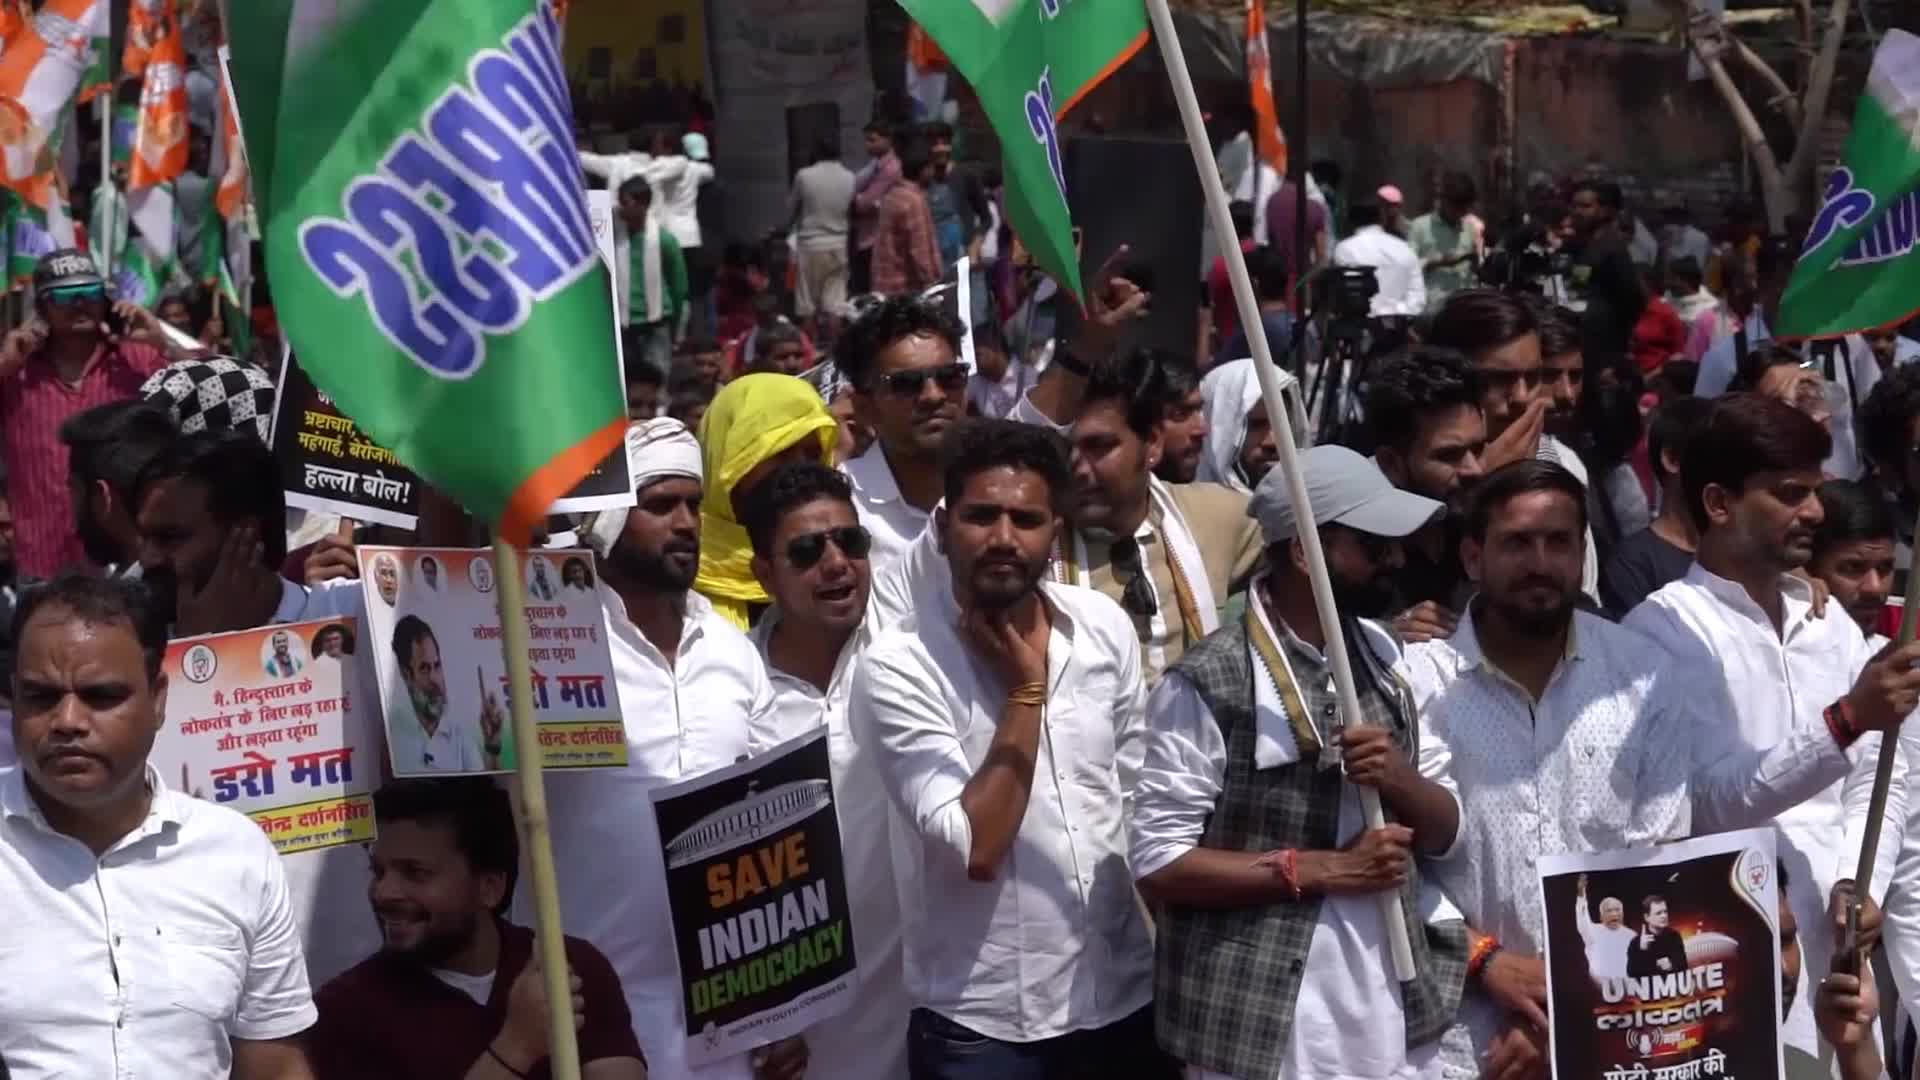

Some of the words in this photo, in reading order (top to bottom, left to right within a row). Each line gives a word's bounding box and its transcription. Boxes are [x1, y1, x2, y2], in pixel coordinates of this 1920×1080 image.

[303, 462, 359, 494] हल्ला
[361, 468, 411, 504] बोल!
[556, 674, 607, 708] मत
[180, 711, 234, 736] लोकतंत्र
[237, 708, 253, 725] के
[315, 699, 338, 713] रहा
[216, 733, 242, 752] और
[244, 729, 284, 750] लड़ता
[210, 751, 276, 803] डरो
[287, 746, 356, 787] मत
[706, 831, 810, 909] SAVE
[697, 877, 830, 971] INDIAN
[690, 919, 843, 1015] DEMOCRACY
[1602, 961, 1724, 1003] UNMUTE
[1702, 1047, 1726, 1075] की
